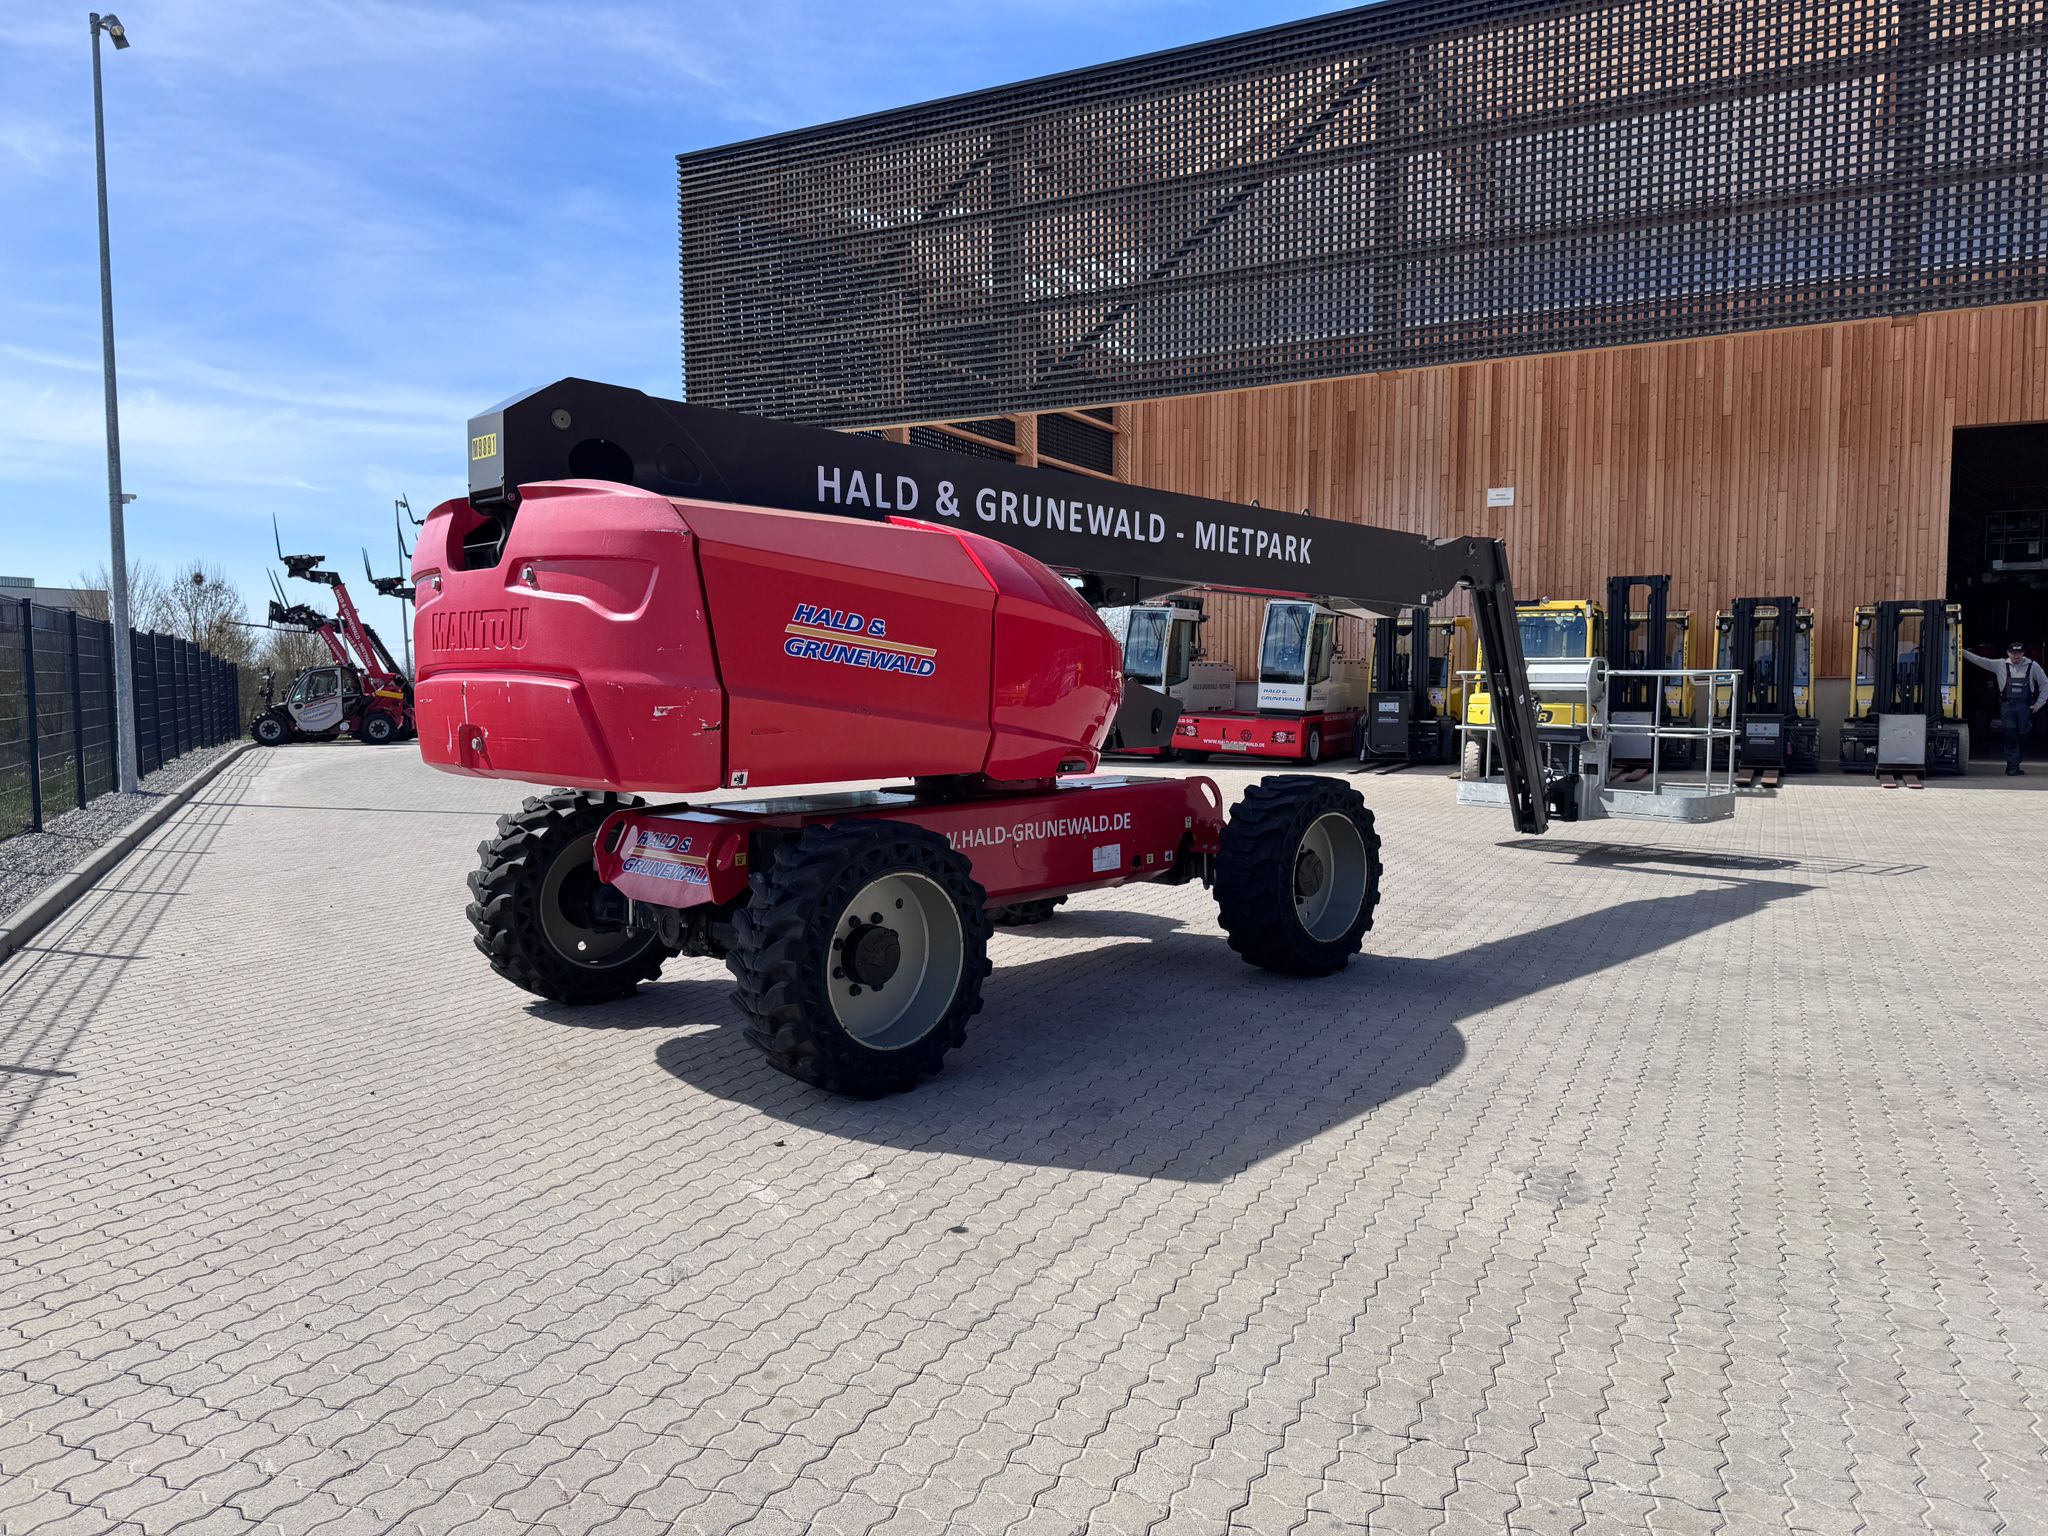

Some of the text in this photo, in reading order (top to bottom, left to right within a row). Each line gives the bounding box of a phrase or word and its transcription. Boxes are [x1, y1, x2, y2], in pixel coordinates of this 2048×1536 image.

[817, 465, 919, 511] HALD
[935, 480, 960, 518] &
[976, 488, 1166, 543] GRUNEWALD
[1195, 520, 1312, 565] MIETPARK
[432, 607, 530, 651] MANITOU
[792, 603, 887, 637] HALD &
[784, 637, 936, 677] GRUNEWALD
[637, 831, 693, 852] HALD &
